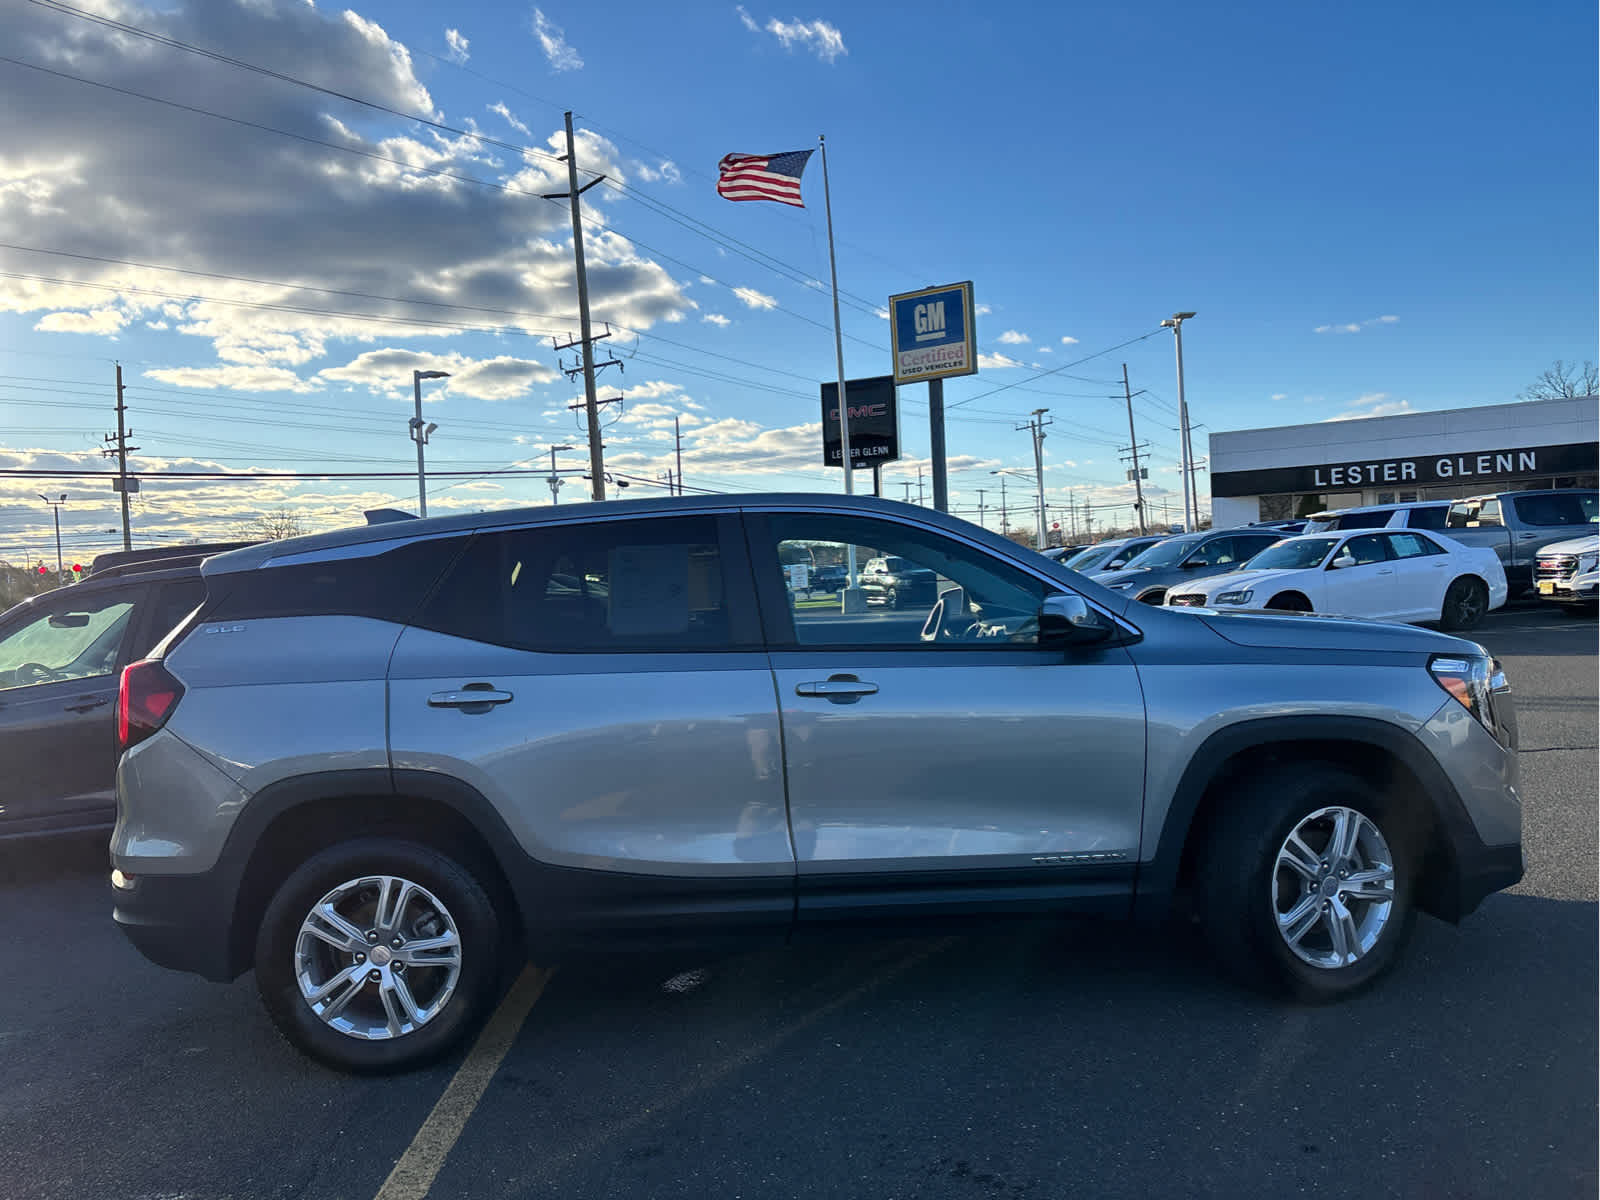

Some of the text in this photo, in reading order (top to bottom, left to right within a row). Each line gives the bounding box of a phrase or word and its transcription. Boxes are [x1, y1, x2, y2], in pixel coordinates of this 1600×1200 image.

[914, 301, 946, 334] GM
[901, 345, 964, 367] Certified
[902, 360, 963, 375] USED VEHICLES
[831, 446, 889, 459] LEER GLENN
[1314, 451, 1537, 486] LESTER GLENN
